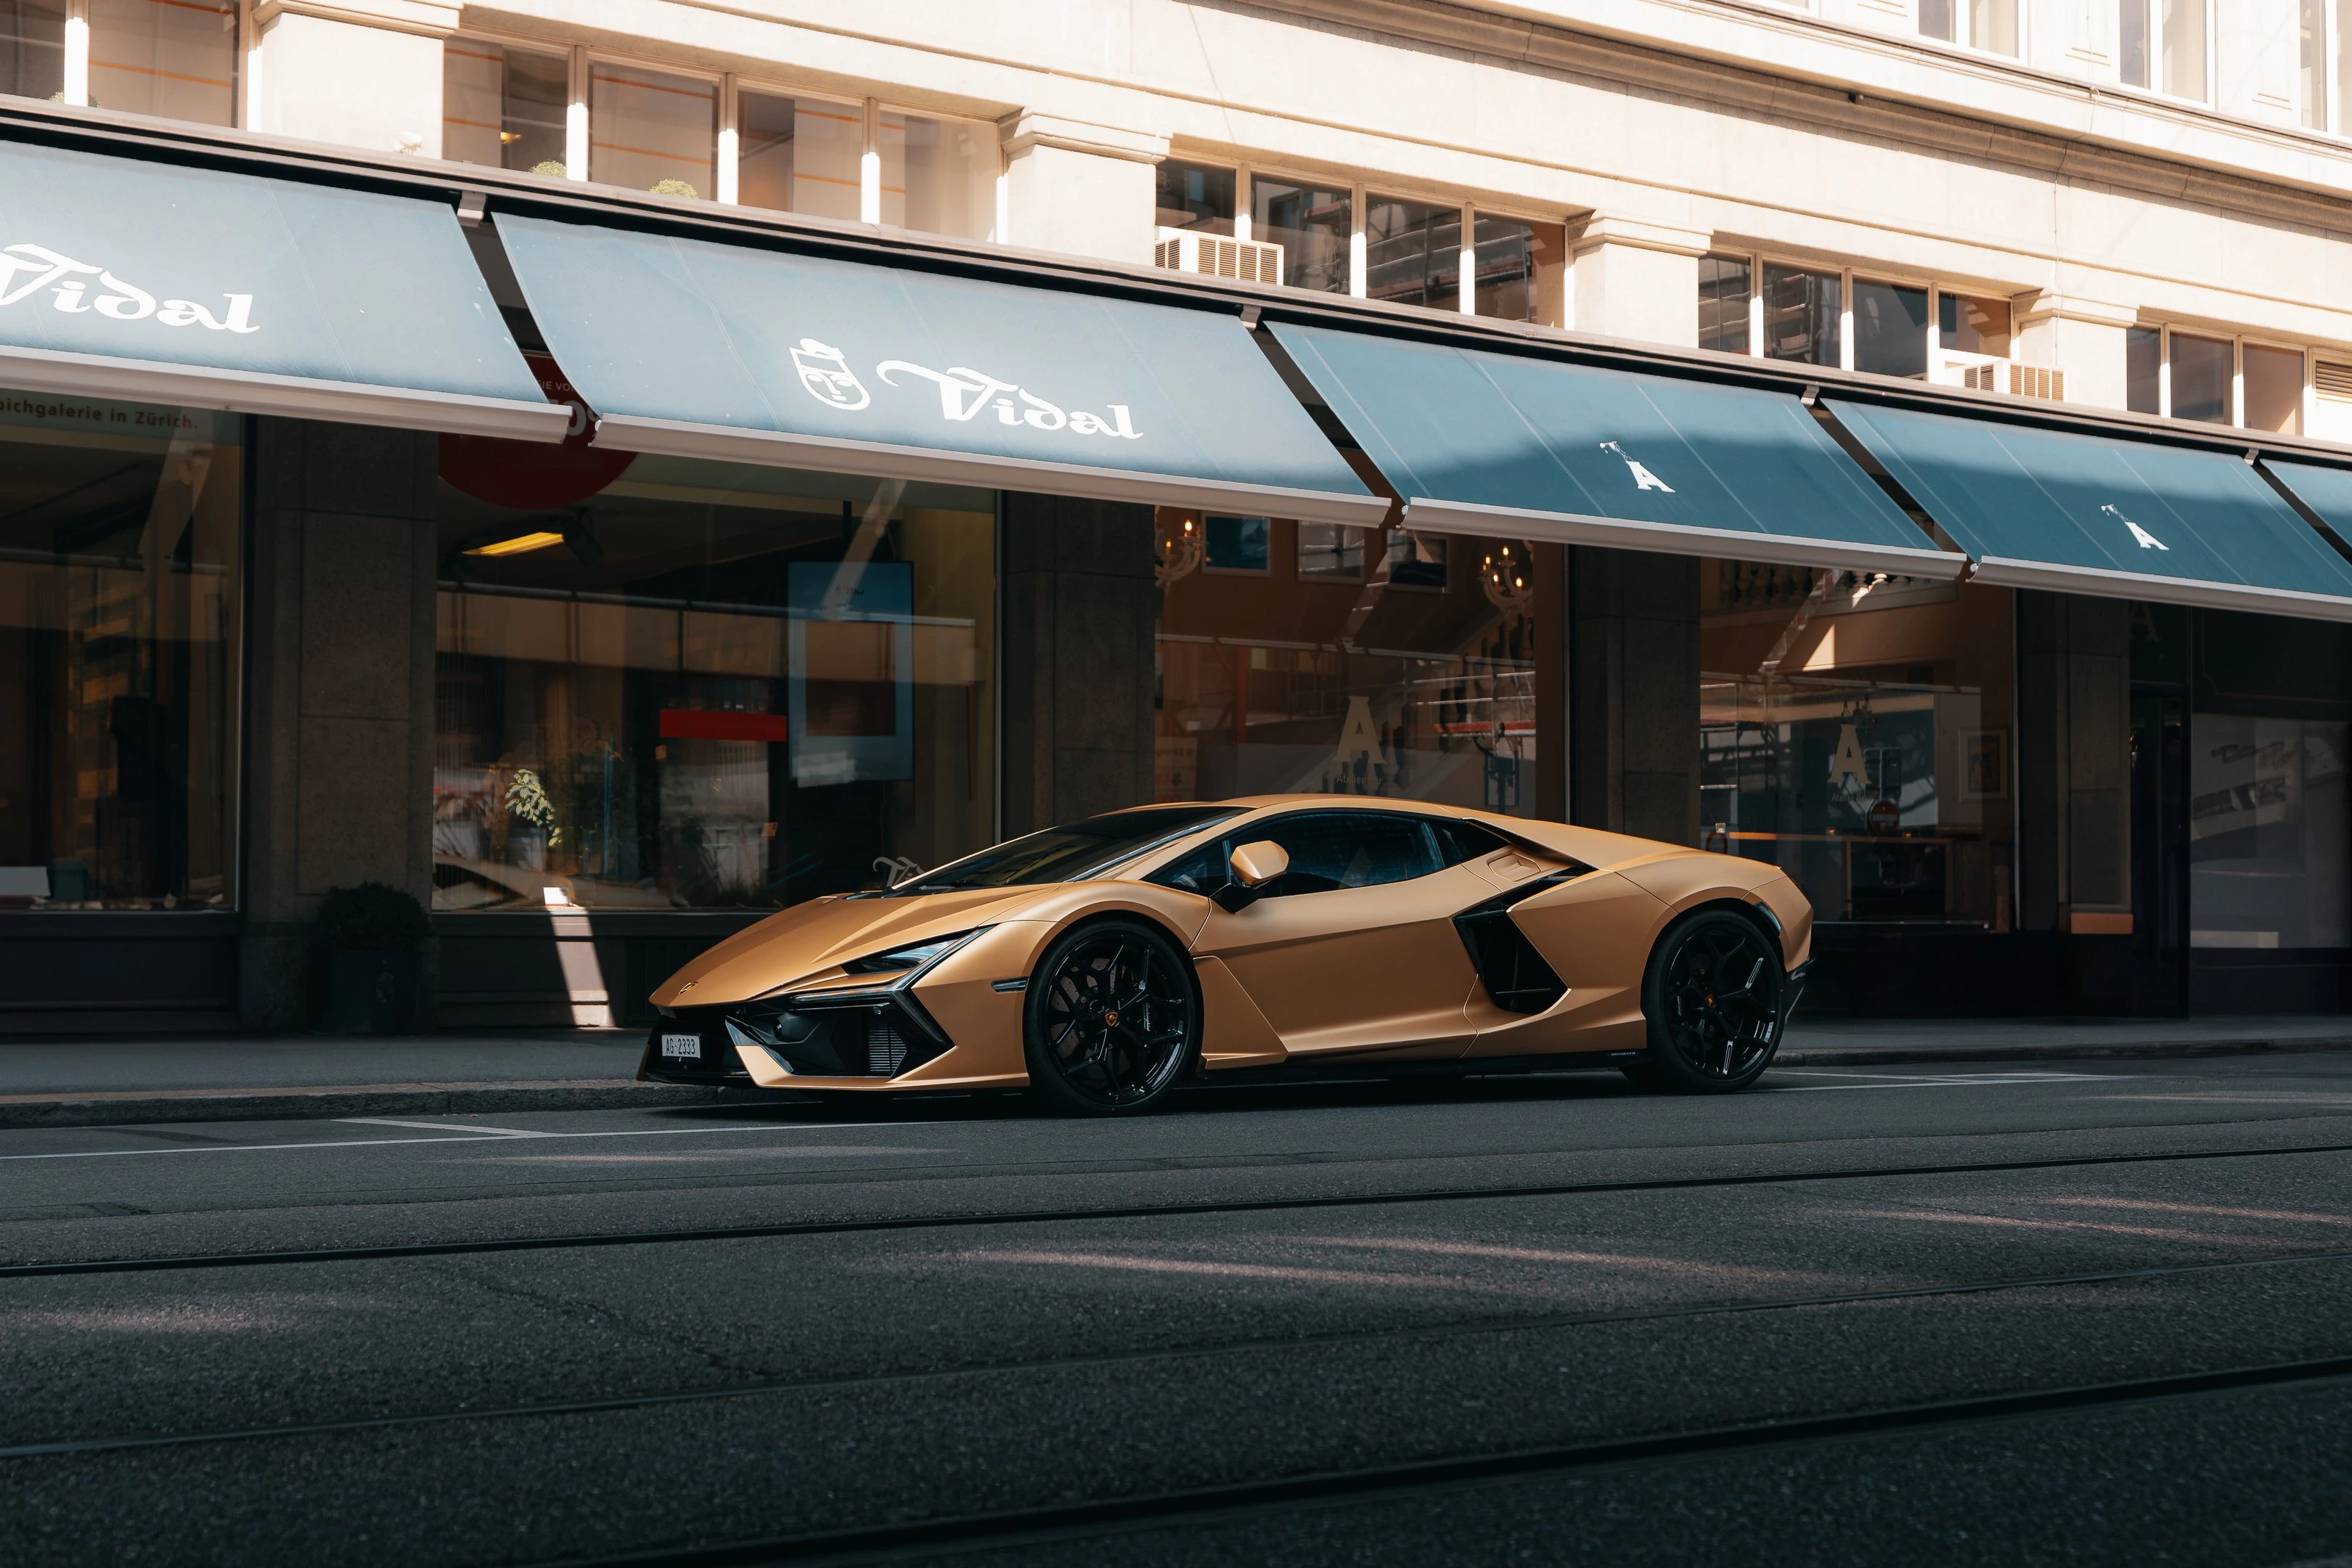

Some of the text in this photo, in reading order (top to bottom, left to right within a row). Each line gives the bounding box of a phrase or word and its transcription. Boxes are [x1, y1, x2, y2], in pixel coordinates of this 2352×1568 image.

[110, 407, 126, 422] in
[135, 411, 198, 429] Zürich.
[876, 360, 1143, 438] Vidal
[1626, 460, 1676, 493] A
[2125, 521, 2170, 550] A
[1333, 695, 1388, 764] A
[1826, 723, 1872, 784] A
